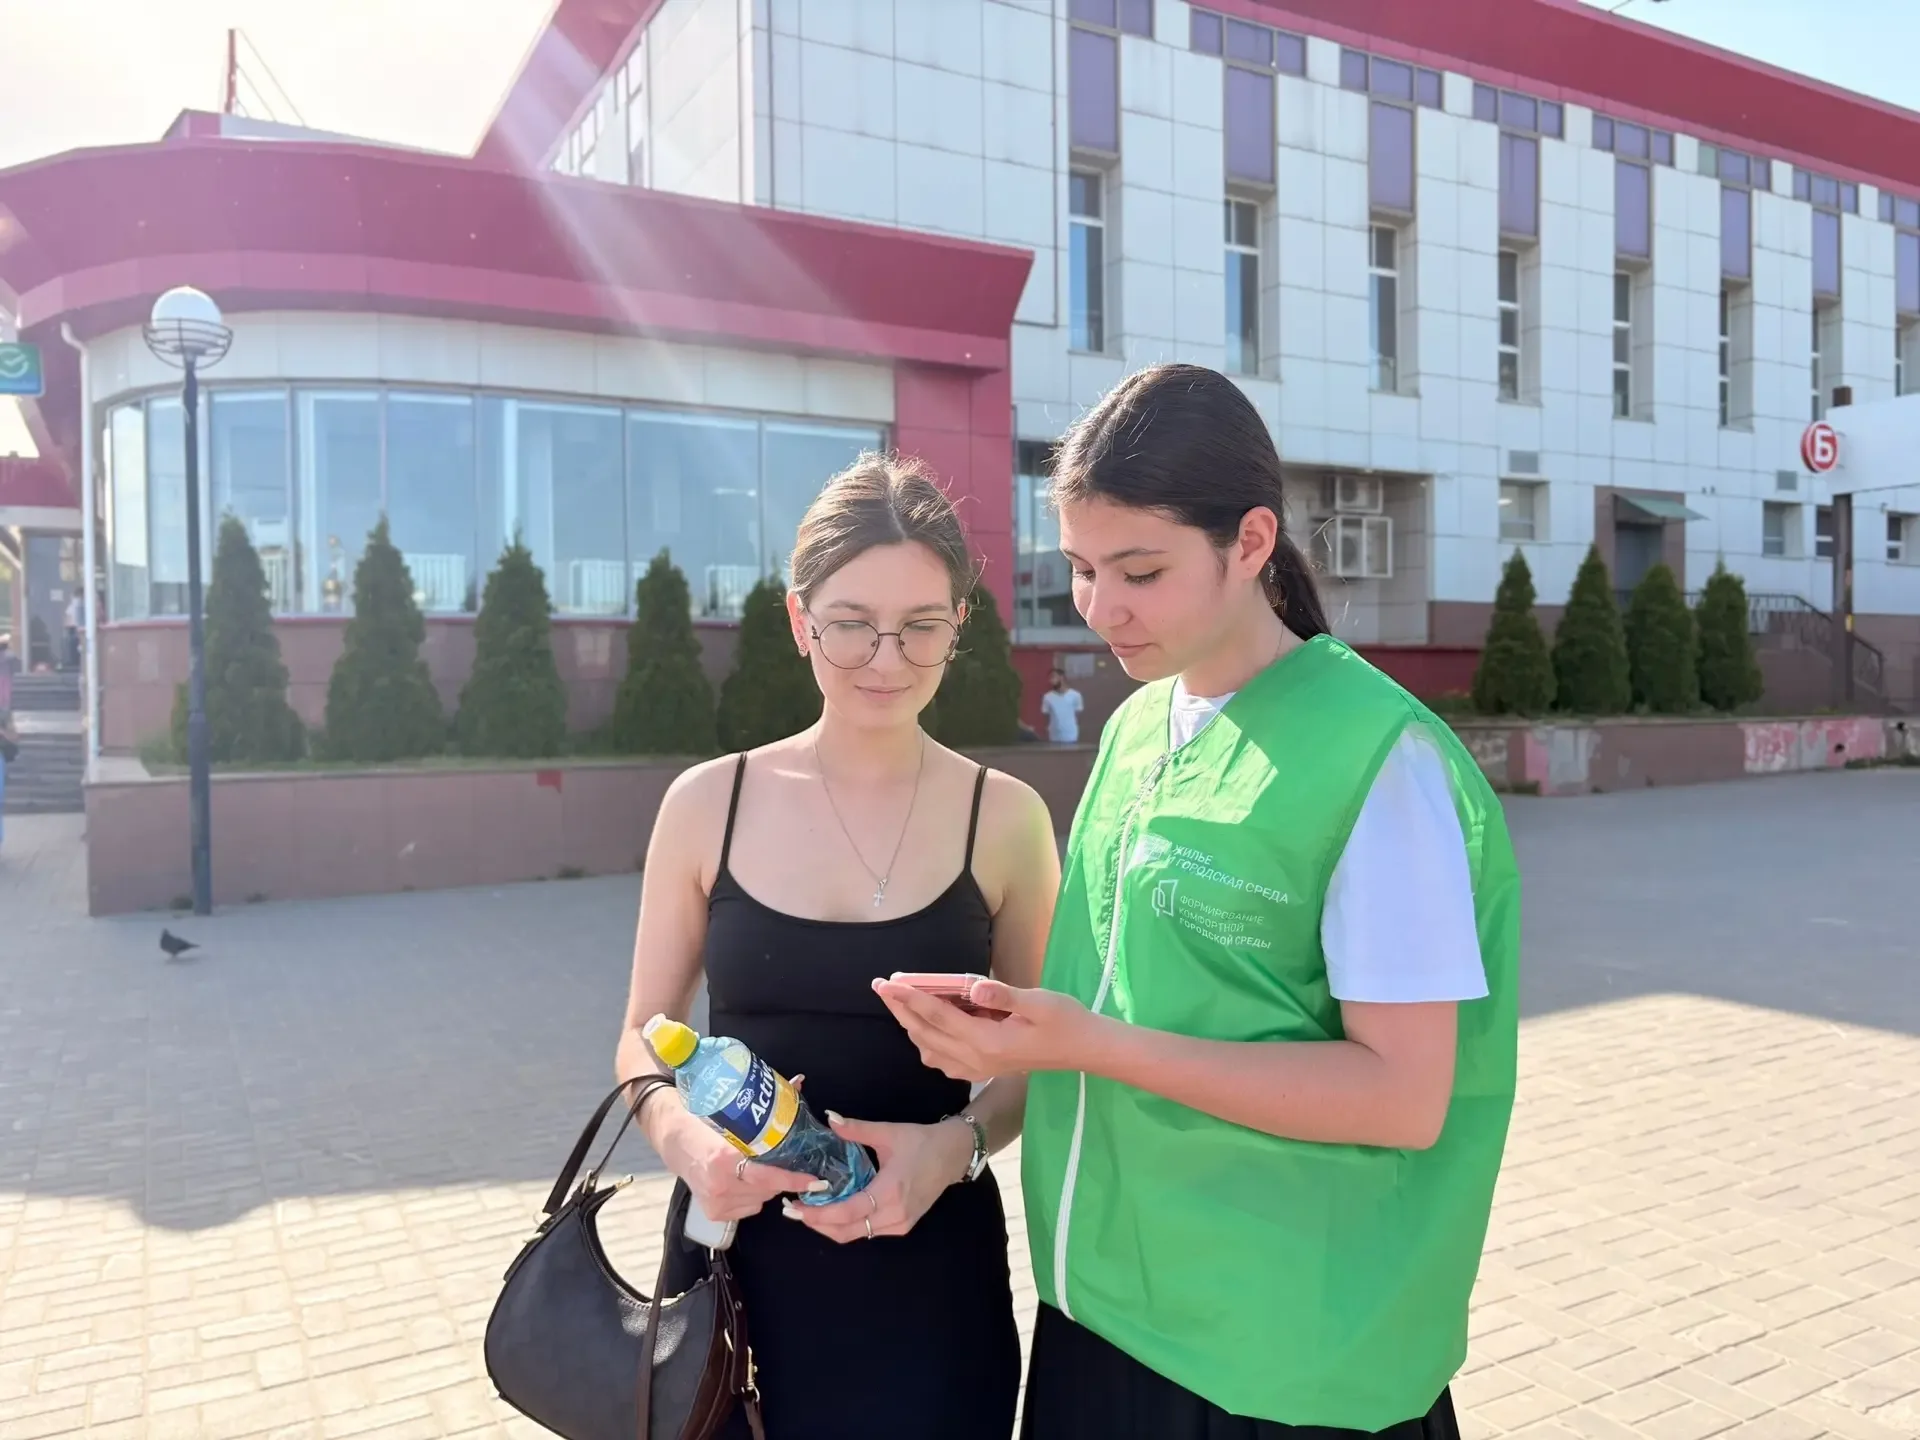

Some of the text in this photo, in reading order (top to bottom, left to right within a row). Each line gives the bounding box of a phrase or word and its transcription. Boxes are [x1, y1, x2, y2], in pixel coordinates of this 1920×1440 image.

[1814, 428, 1834, 463] Б
[1172, 844, 1214, 865] ЖИЛЬЕ
[1175, 858, 1244, 890] ГОРОДСКАЯ
[1245, 882, 1289, 905] СРЕДА
[1178, 907, 1245, 933] КОМФОРТНОЙ
[1180, 895, 1265, 925] ФОРМИРОВАНИЕ
[1179, 917, 1272, 950] ГОРОДСКОЙ СРЕДЫ
